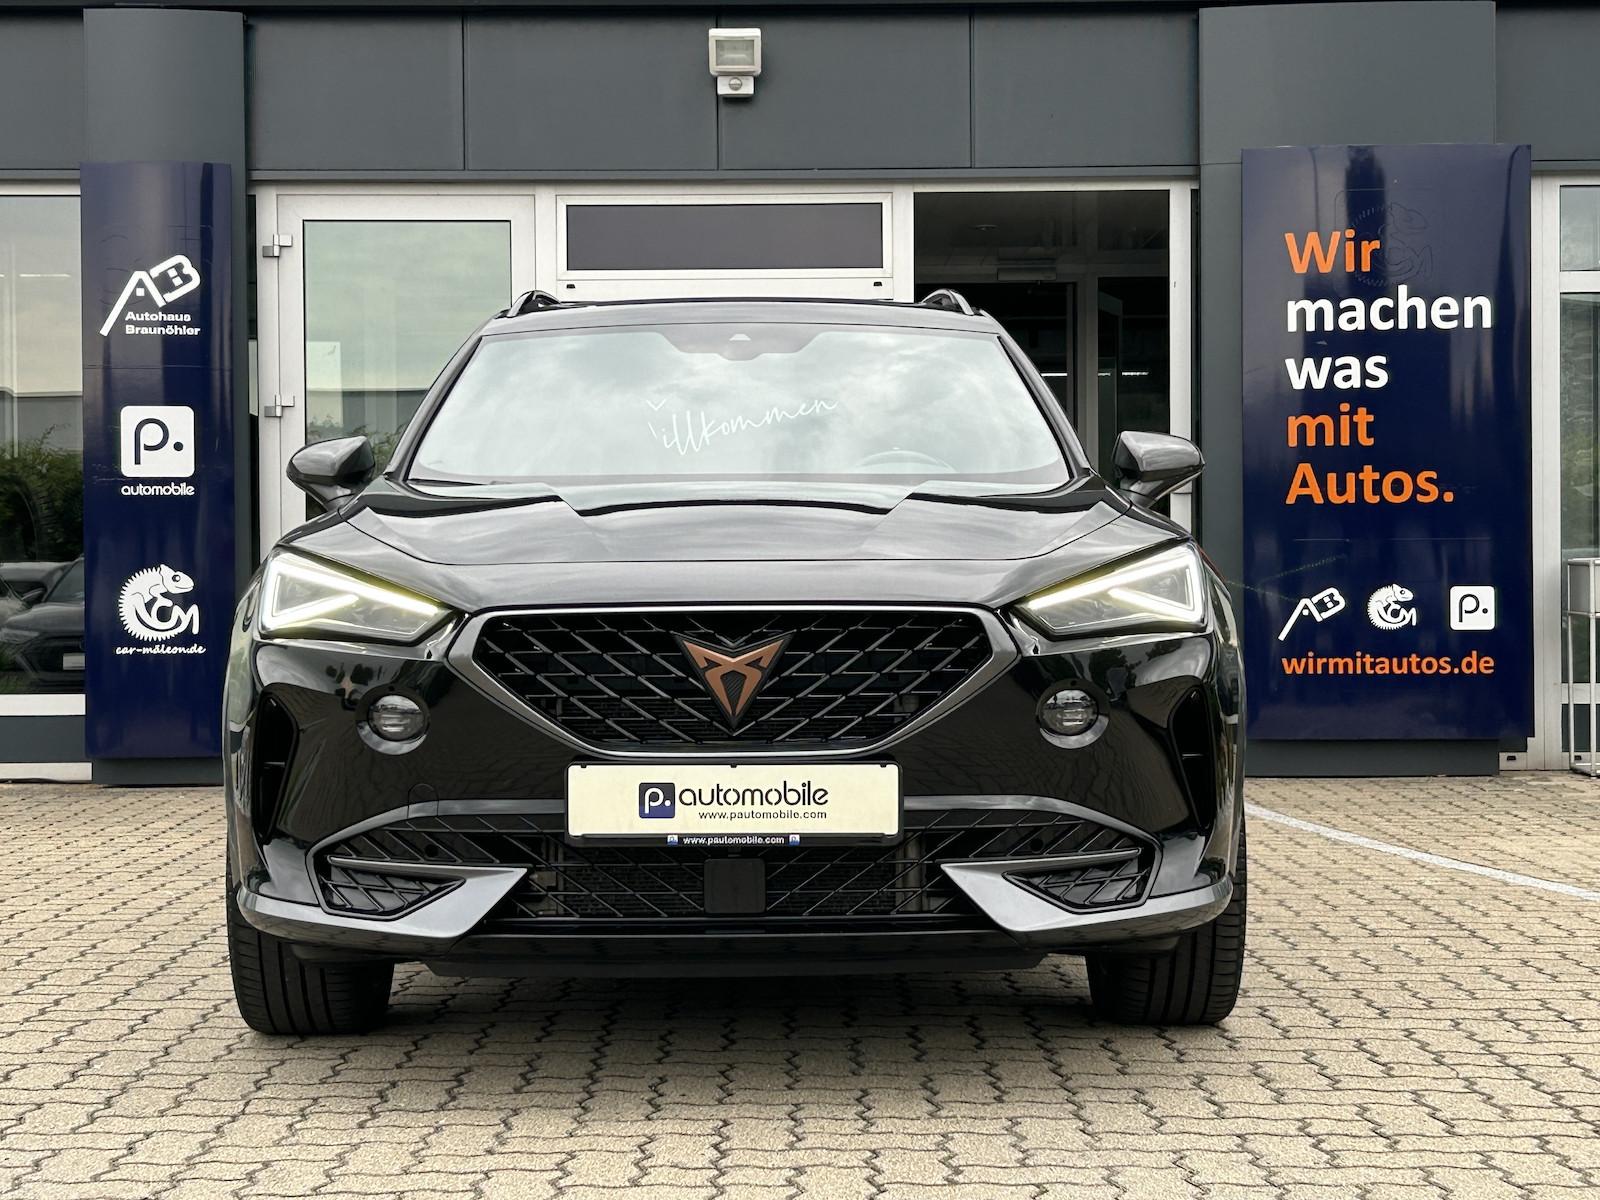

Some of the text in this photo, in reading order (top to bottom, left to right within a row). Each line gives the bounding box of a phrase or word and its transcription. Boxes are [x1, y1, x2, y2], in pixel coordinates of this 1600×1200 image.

[1284, 229, 1380, 273] Wir
[125, 311, 191, 321] Autohaus
[1287, 284, 1492, 332] machen
[125, 324, 200, 335] Braunöhler
[1284, 355, 1389, 390] was
[647, 398, 838, 455] illkommen
[1287, 402, 1375, 447] mit
[121, 482, 195, 496] automobile
[1285, 462, 1454, 504] Autos.
[1281, 651, 1495, 675] wirmitautos.de
[678, 780, 829, 806] automobile
[698, 809, 828, 821] www.pautomobile.com
[682, 834, 786, 846] www.pautomobile.com
